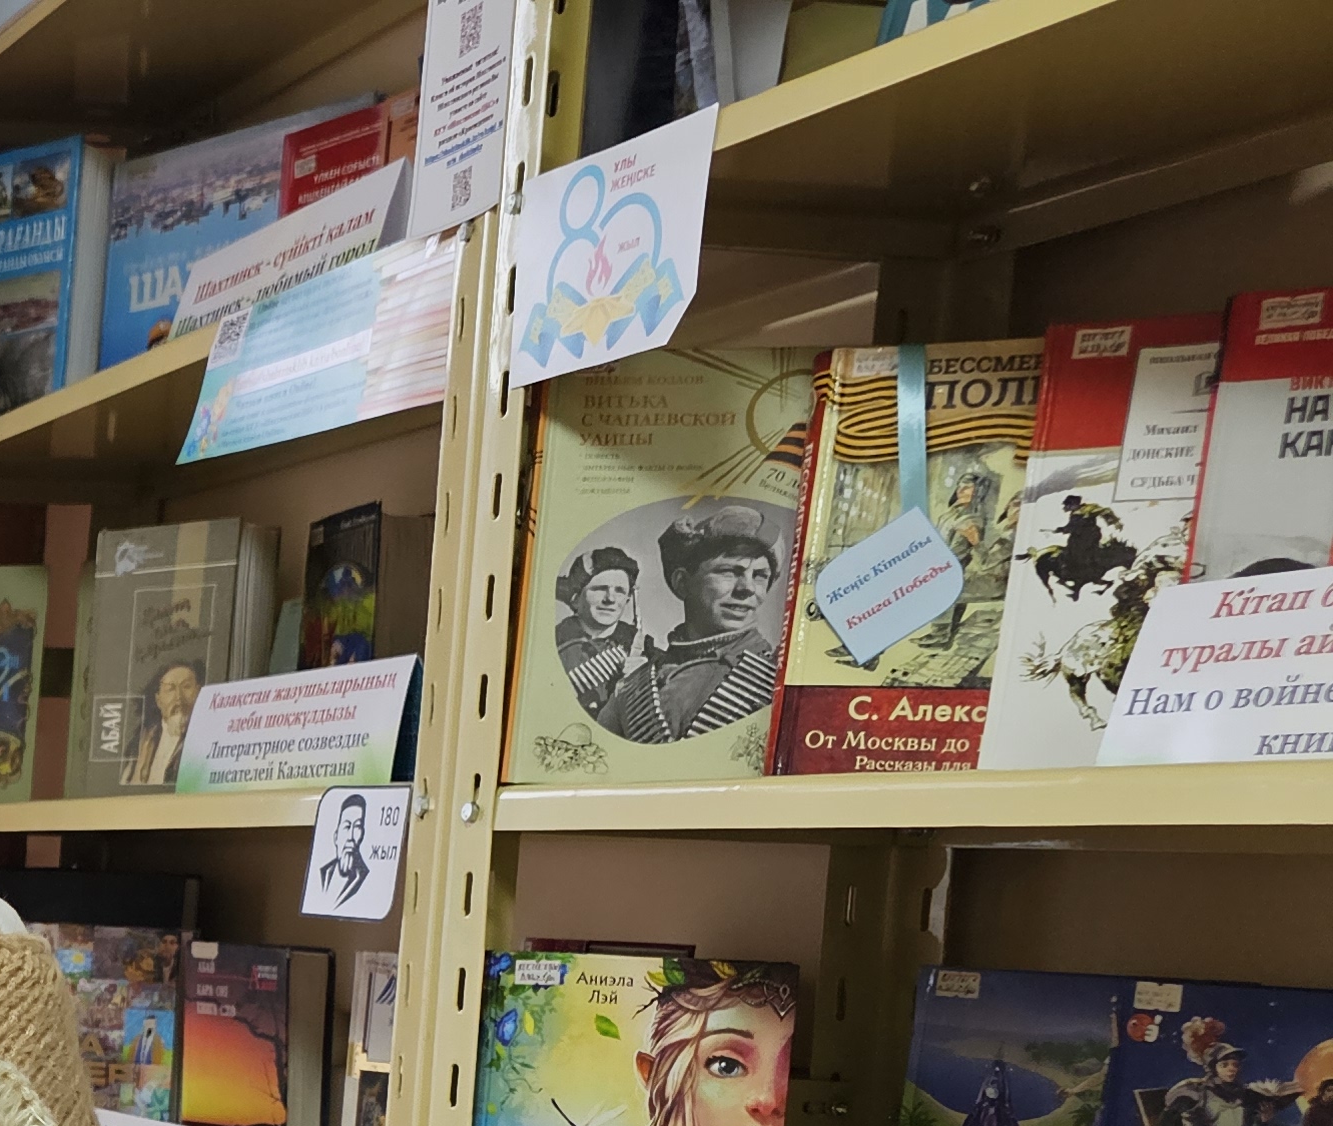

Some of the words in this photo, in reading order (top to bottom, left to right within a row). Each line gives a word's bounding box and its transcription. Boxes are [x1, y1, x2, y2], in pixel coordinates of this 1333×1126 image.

[175, 299, 247, 338] Шахтинск
[252, 252, 326, 305] любимый
[326, 237, 378, 272] город
[193, 261, 264, 305] Шахтинск
[583, 395, 670, 410] ВИТЬКА
[1284, 394, 1331, 425] НА
[581, 414, 593, 428] С
[598, 410, 737, 428] ЧАПАЕВСКОЙ
[1143, 424, 1199, 436] Михаил
[579, 433, 653, 448] УЛИЦЫ
[1126, 445, 1196, 463] ДОНСКИЕ
[767, 467, 787, 483] 70
[1130, 475, 1184, 489] СУДЬБА
[870, 535, 933, 580] Кітабы
[845, 595, 893, 631] Книга
[892, 560, 953, 601] Победы
[1210, 587, 1315, 619] Кітап
[1160, 637, 1289, 674] туралы
[848, 696, 879, 722] С.
[1123, 687, 1197, 716] Нам
[1204, 690, 1224, 710] о
[100, 701, 125, 754] АБАЙ
[226, 711, 263, 733] әдеби
[206, 738, 295, 760] Литературное
[297, 731, 370, 753] созвездие
[805, 730, 836, 750] От
[842, 731, 937, 751] Москвы
[941, 737, 970, 755] до
[208, 761, 274, 785] писателей
[276, 760, 355, 781] Казахстана
[854, 756, 937, 773] Рассказы
[380, 805, 401, 826] 180
[369, 845, 398, 860] ЖЫЛ
[576, 971, 635, 988] Аниэла
[588, 990, 619, 1005] Лэй
